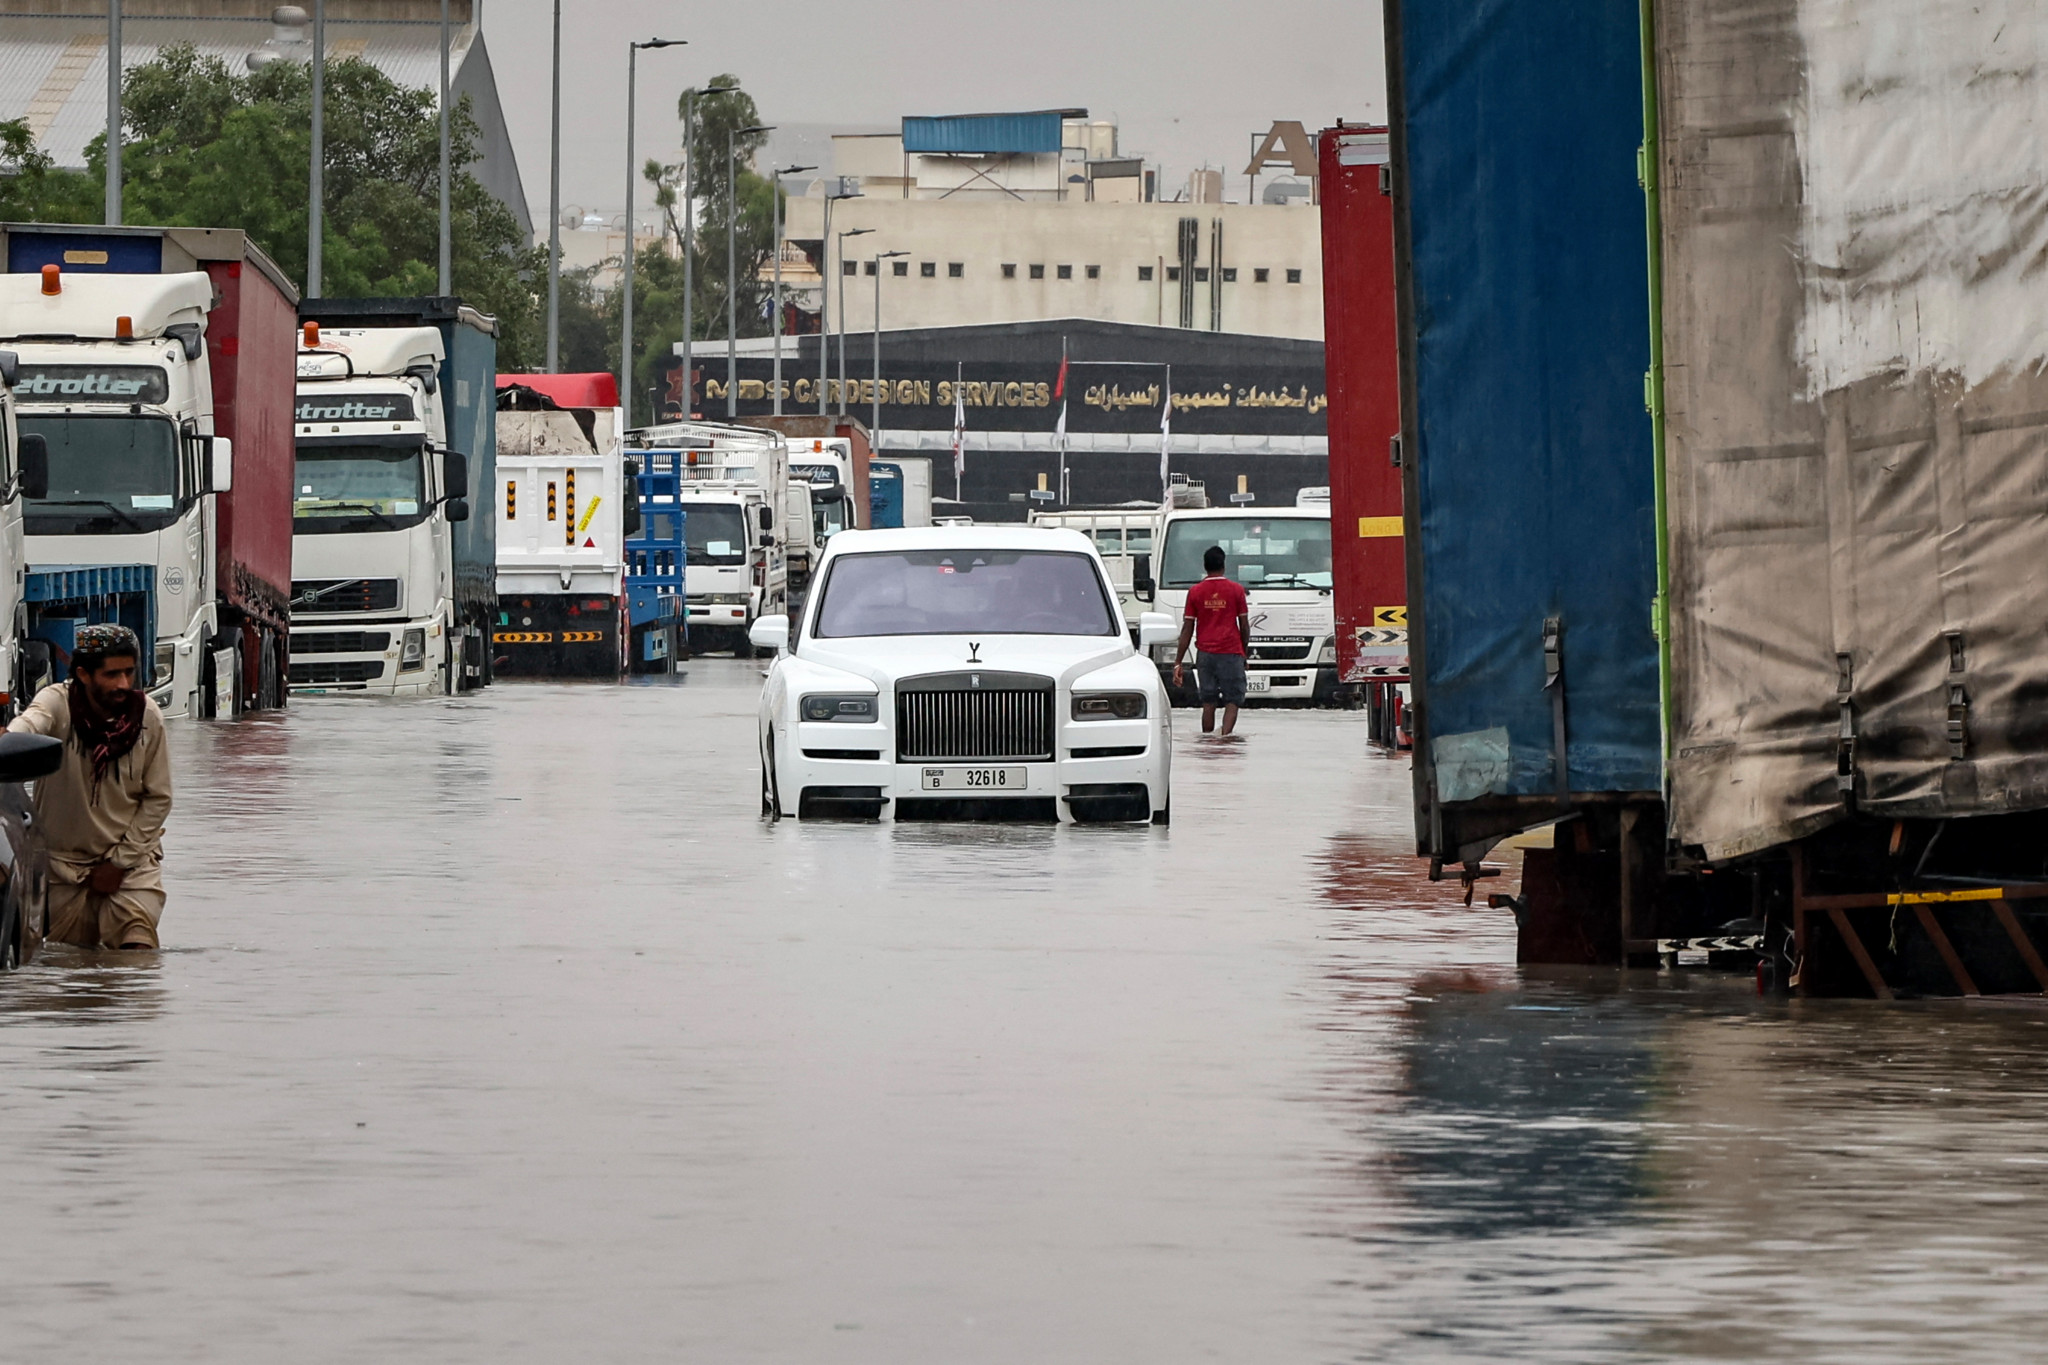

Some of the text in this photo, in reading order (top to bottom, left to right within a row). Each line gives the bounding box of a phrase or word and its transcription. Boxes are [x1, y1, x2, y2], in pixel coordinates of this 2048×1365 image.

[1242, 120, 1320, 176] A
[12, 374, 148, 395] etrotter
[936, 380, 1050, 408] SERVICES
[296, 403, 396, 419] trotter
[932, 771, 1006, 788] B 32618
